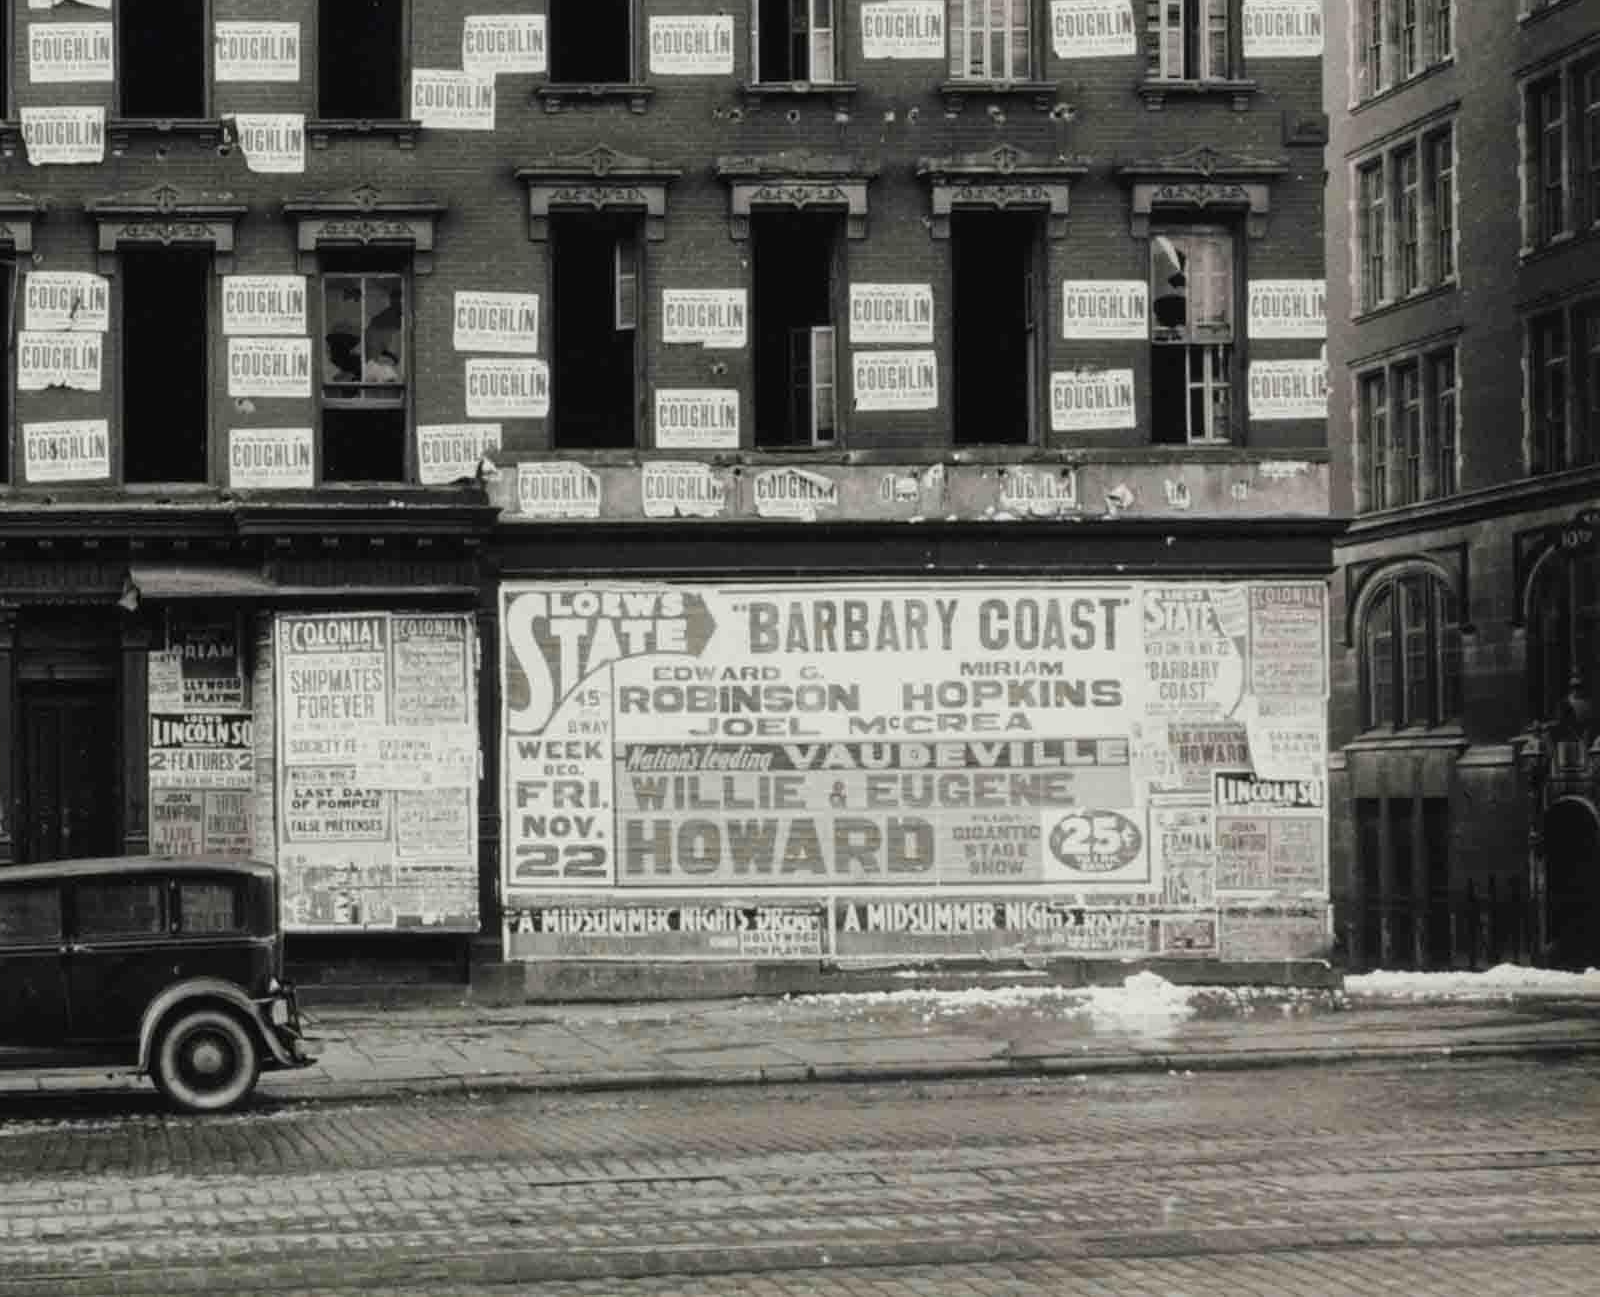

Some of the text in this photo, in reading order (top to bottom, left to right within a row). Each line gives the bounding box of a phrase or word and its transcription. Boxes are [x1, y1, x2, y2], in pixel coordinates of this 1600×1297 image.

[1056, 11, 1131, 37] COUGHLIN
[32, 37, 112, 61] COUGHLIN
[465, 29, 545, 53] COUGHLIN
[652, 30, 732, 54] COUGHLIN
[24, 121, 104, 145] COUGHLIN
[225, 289, 305, 313] COUGHLIN
[852, 298, 932, 322] COUGHLIN
[457, 307, 537, 331] COUGHLIN
[470, 373, 546, 398] COUGHLIN
[1252, 373, 1327, 399] COUGHLIN
[28, 435, 105, 460] COUGHLIN
[292, 621, 383, 651] COLONIAL
[505, 591, 688, 734] STATE
[653, 661, 1064, 681] EDWARD G. MIRIAM
[290, 669, 383, 694] SHIPMATES
[297, 694, 375, 718] FOREVER
[619, 679, 1123, 713] ROBINSON HOPKINS
[152, 717, 229, 747] LINCOLN
[688, 718, 820, 736] JOEL
[151, 753, 166, 770] 2
[172, 753, 236, 770] FEATURES
[516, 741, 604, 759] WEEK
[782, 739, 1130, 771] VAUDEVILLE
[1180, 744, 1248, 764] HOWARD
[295, 788, 384, 798] LAST DAYS
[516, 781, 608, 809] FRI.
[632, 772, 1075, 811] WILLIE & EUGENE
[1217, 776, 1297, 804] LINCOLN
[291, 799, 308, 809] OF
[522, 815, 604, 838] NOV.
[951, 825, 1041, 841] GIGANTIC
[626, 816, 936, 876] HOWARD
[515, 844, 608, 878] 22
[968, 860, 1025, 875] SHOW
[542, 908, 670, 934] MIDSUMMER
[843, 905, 861, 932] A
[867, 903, 995, 933] MIDSUMMER
